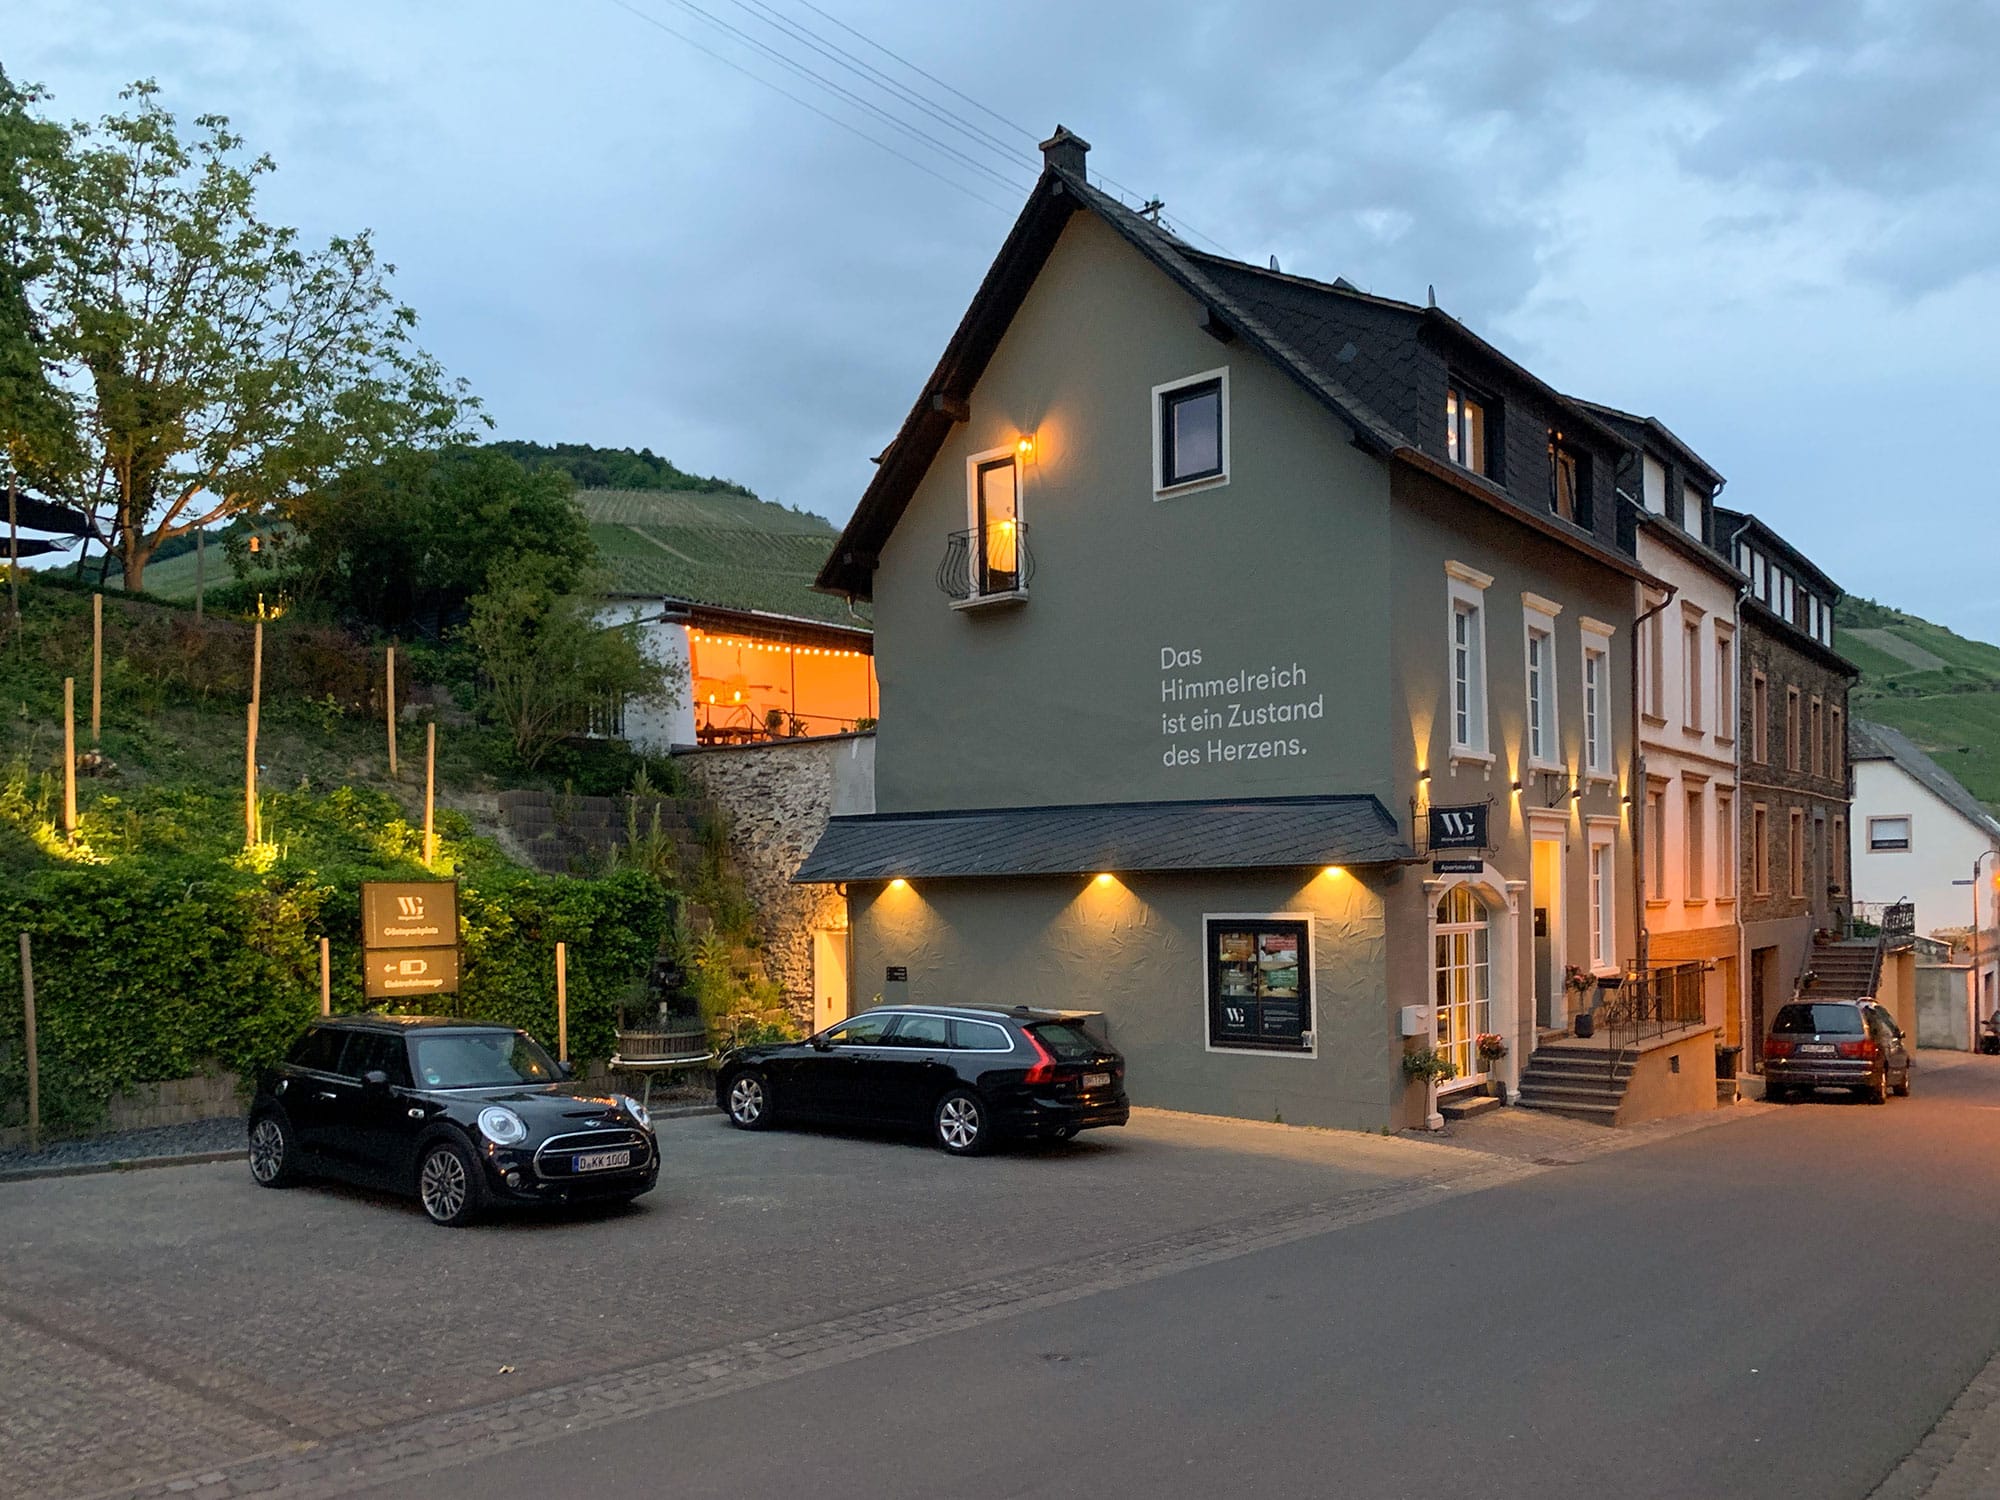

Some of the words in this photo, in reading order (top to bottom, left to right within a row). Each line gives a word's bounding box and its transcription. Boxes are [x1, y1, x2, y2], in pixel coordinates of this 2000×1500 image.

[1160, 646, 1203, 670] Das
[1161, 662, 1307, 703] Himmelreich
[1162, 712, 1187, 735] ist
[1190, 708, 1223, 732] ein
[1227, 693, 1325, 729] Zustand
[1162, 743, 1201, 768] des
[1206, 737, 1308, 763] Herzens.
[1440, 811, 1476, 836] WG
